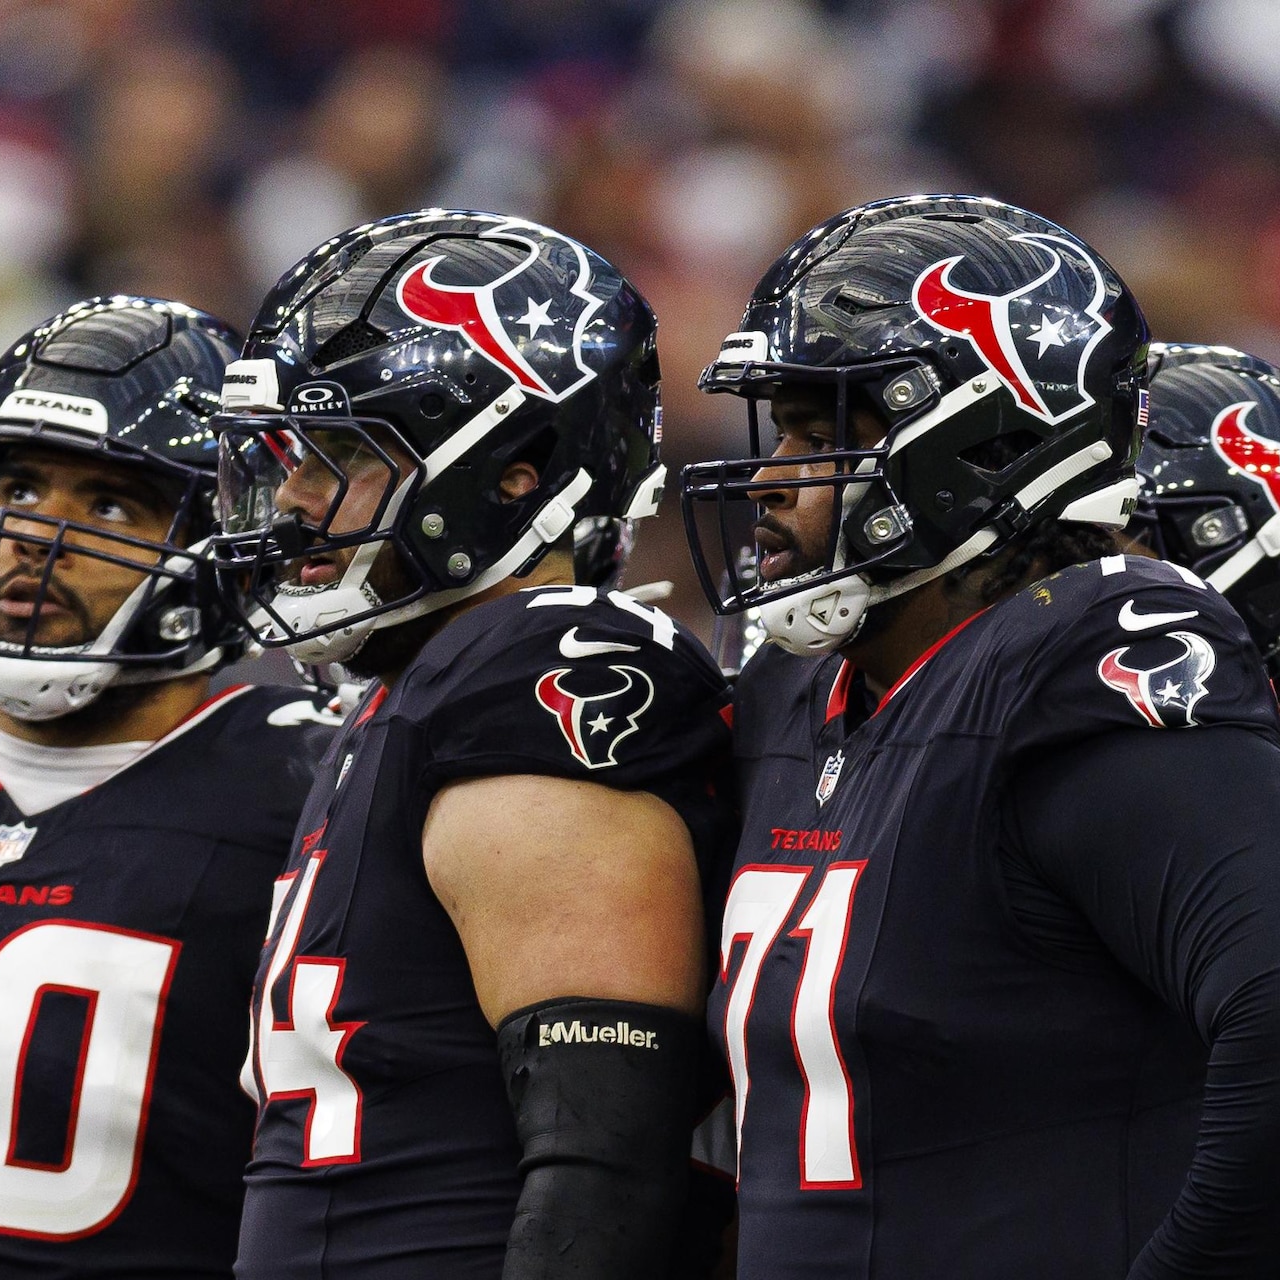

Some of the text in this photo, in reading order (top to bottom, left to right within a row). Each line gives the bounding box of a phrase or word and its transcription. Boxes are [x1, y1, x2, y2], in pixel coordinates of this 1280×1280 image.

[14, 396, 94, 416] TEXANS
[290, 401, 344, 413] OAKLEY
[770, 828, 843, 852] TEXANS
[719, 858, 869, 1193] 71
